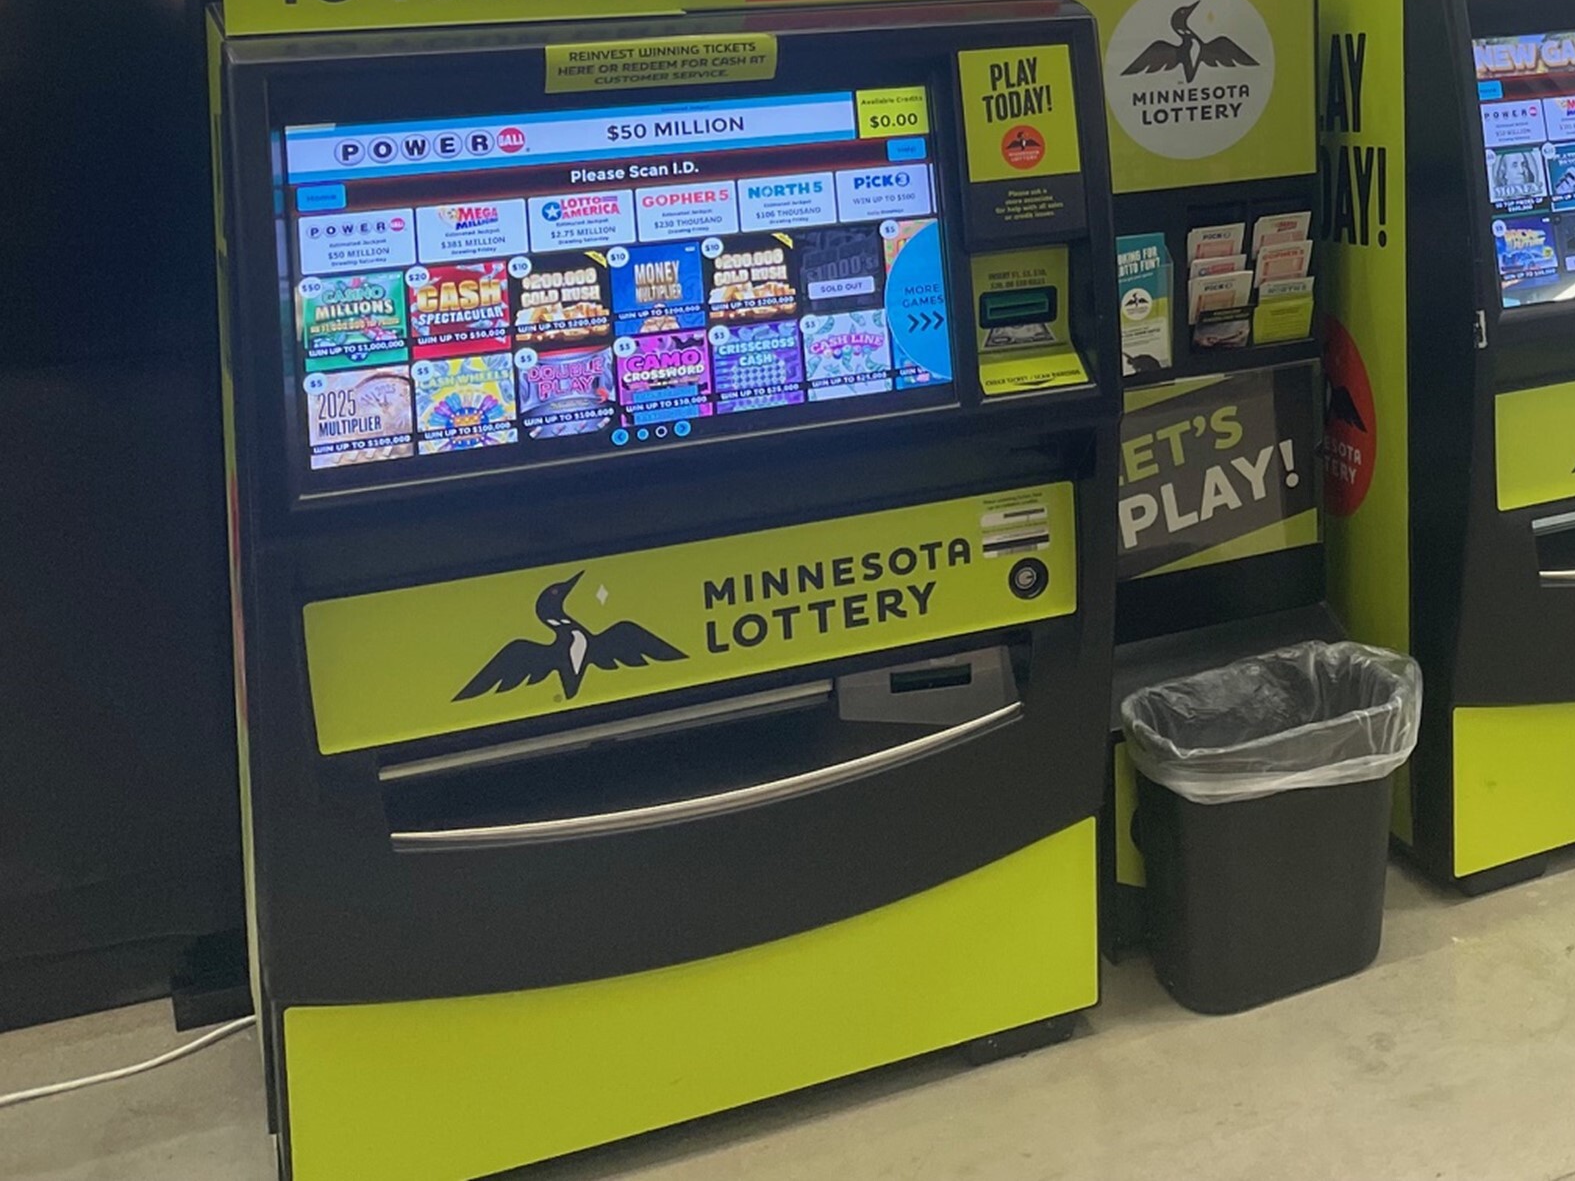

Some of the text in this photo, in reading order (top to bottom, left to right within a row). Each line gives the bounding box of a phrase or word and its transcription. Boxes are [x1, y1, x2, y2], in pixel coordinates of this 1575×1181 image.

[569, 42, 756, 62] REINVEST WINNING TICKETS
[1474, 43, 1538, 72] NEW
[557, 54, 766, 76] HERE OR REDEEM FOR CASH AT
[989, 57, 1038, 91] PLAY
[594, 69, 729, 85] CUSTOMER SERVICE
[1320, 32, 1367, 133] AY
[860, 93, 923, 107] Available Credits
[981, 85, 1053, 124] TODAY!
[1132, 83, 1250, 107] MINNESOTA
[869, 112, 919, 129] $0.00
[1141, 102, 1243, 126] LOTTERY
[607, 123, 647, 141] $50
[654, 116, 745, 138] MILLION
[571, 161, 699, 184] Please Scan I.D.
[642, 189, 729, 208] GOPHER 5
[748, 181, 823, 199] NORTH 5
[560, 195, 602, 210] LOTTO
[561, 203, 620, 219] AMERICA
[456, 206, 498, 221] MEGA
[676, 215, 723, 227] THOUSAND
[777, 207, 821, 218] THOUSAND
[578, 226, 616, 237] MILLION
[466, 236, 506, 247] MILLION
[705, 243, 720, 253] $10
[328, 247, 390, 260] $50 MILLION
[610, 252, 625, 262] $10
[512, 262, 528, 272] $10
[634, 260, 680, 284] MONEY
[751, 264, 787, 281] RUSH
[408, 272, 427, 283] $20
[301, 282, 321, 293] $50
[321, 285, 386, 303] CASINO
[415, 278, 502, 314] CASH
[561, 284, 600, 301] RUSH
[820, 282, 863, 294] SOLD OUT
[904, 283, 940, 295] MORE
[314, 299, 394, 322] MILLIONS
[902, 296, 945, 309] GAMES
[418, 305, 504, 326] SPECTACULAR
[718, 337, 795, 356] CRISSCROSS
[810, 333, 884, 353] CASH LINE
[625, 348, 702, 371] CAMO
[528, 358, 602, 382] DOUBLE
[622, 363, 705, 384] CROSSWORD
[538, 376, 596, 400] PLAY
[318, 389, 356, 421] 2025
[318, 416, 382, 438] MULTIPLIER
[1119, 405, 1244, 487] ET'S
[1118, 439, 1300, 549] PLAY!
[703, 537, 972, 610] MINNESOTA
[705, 580, 937, 654] LOTTERY
